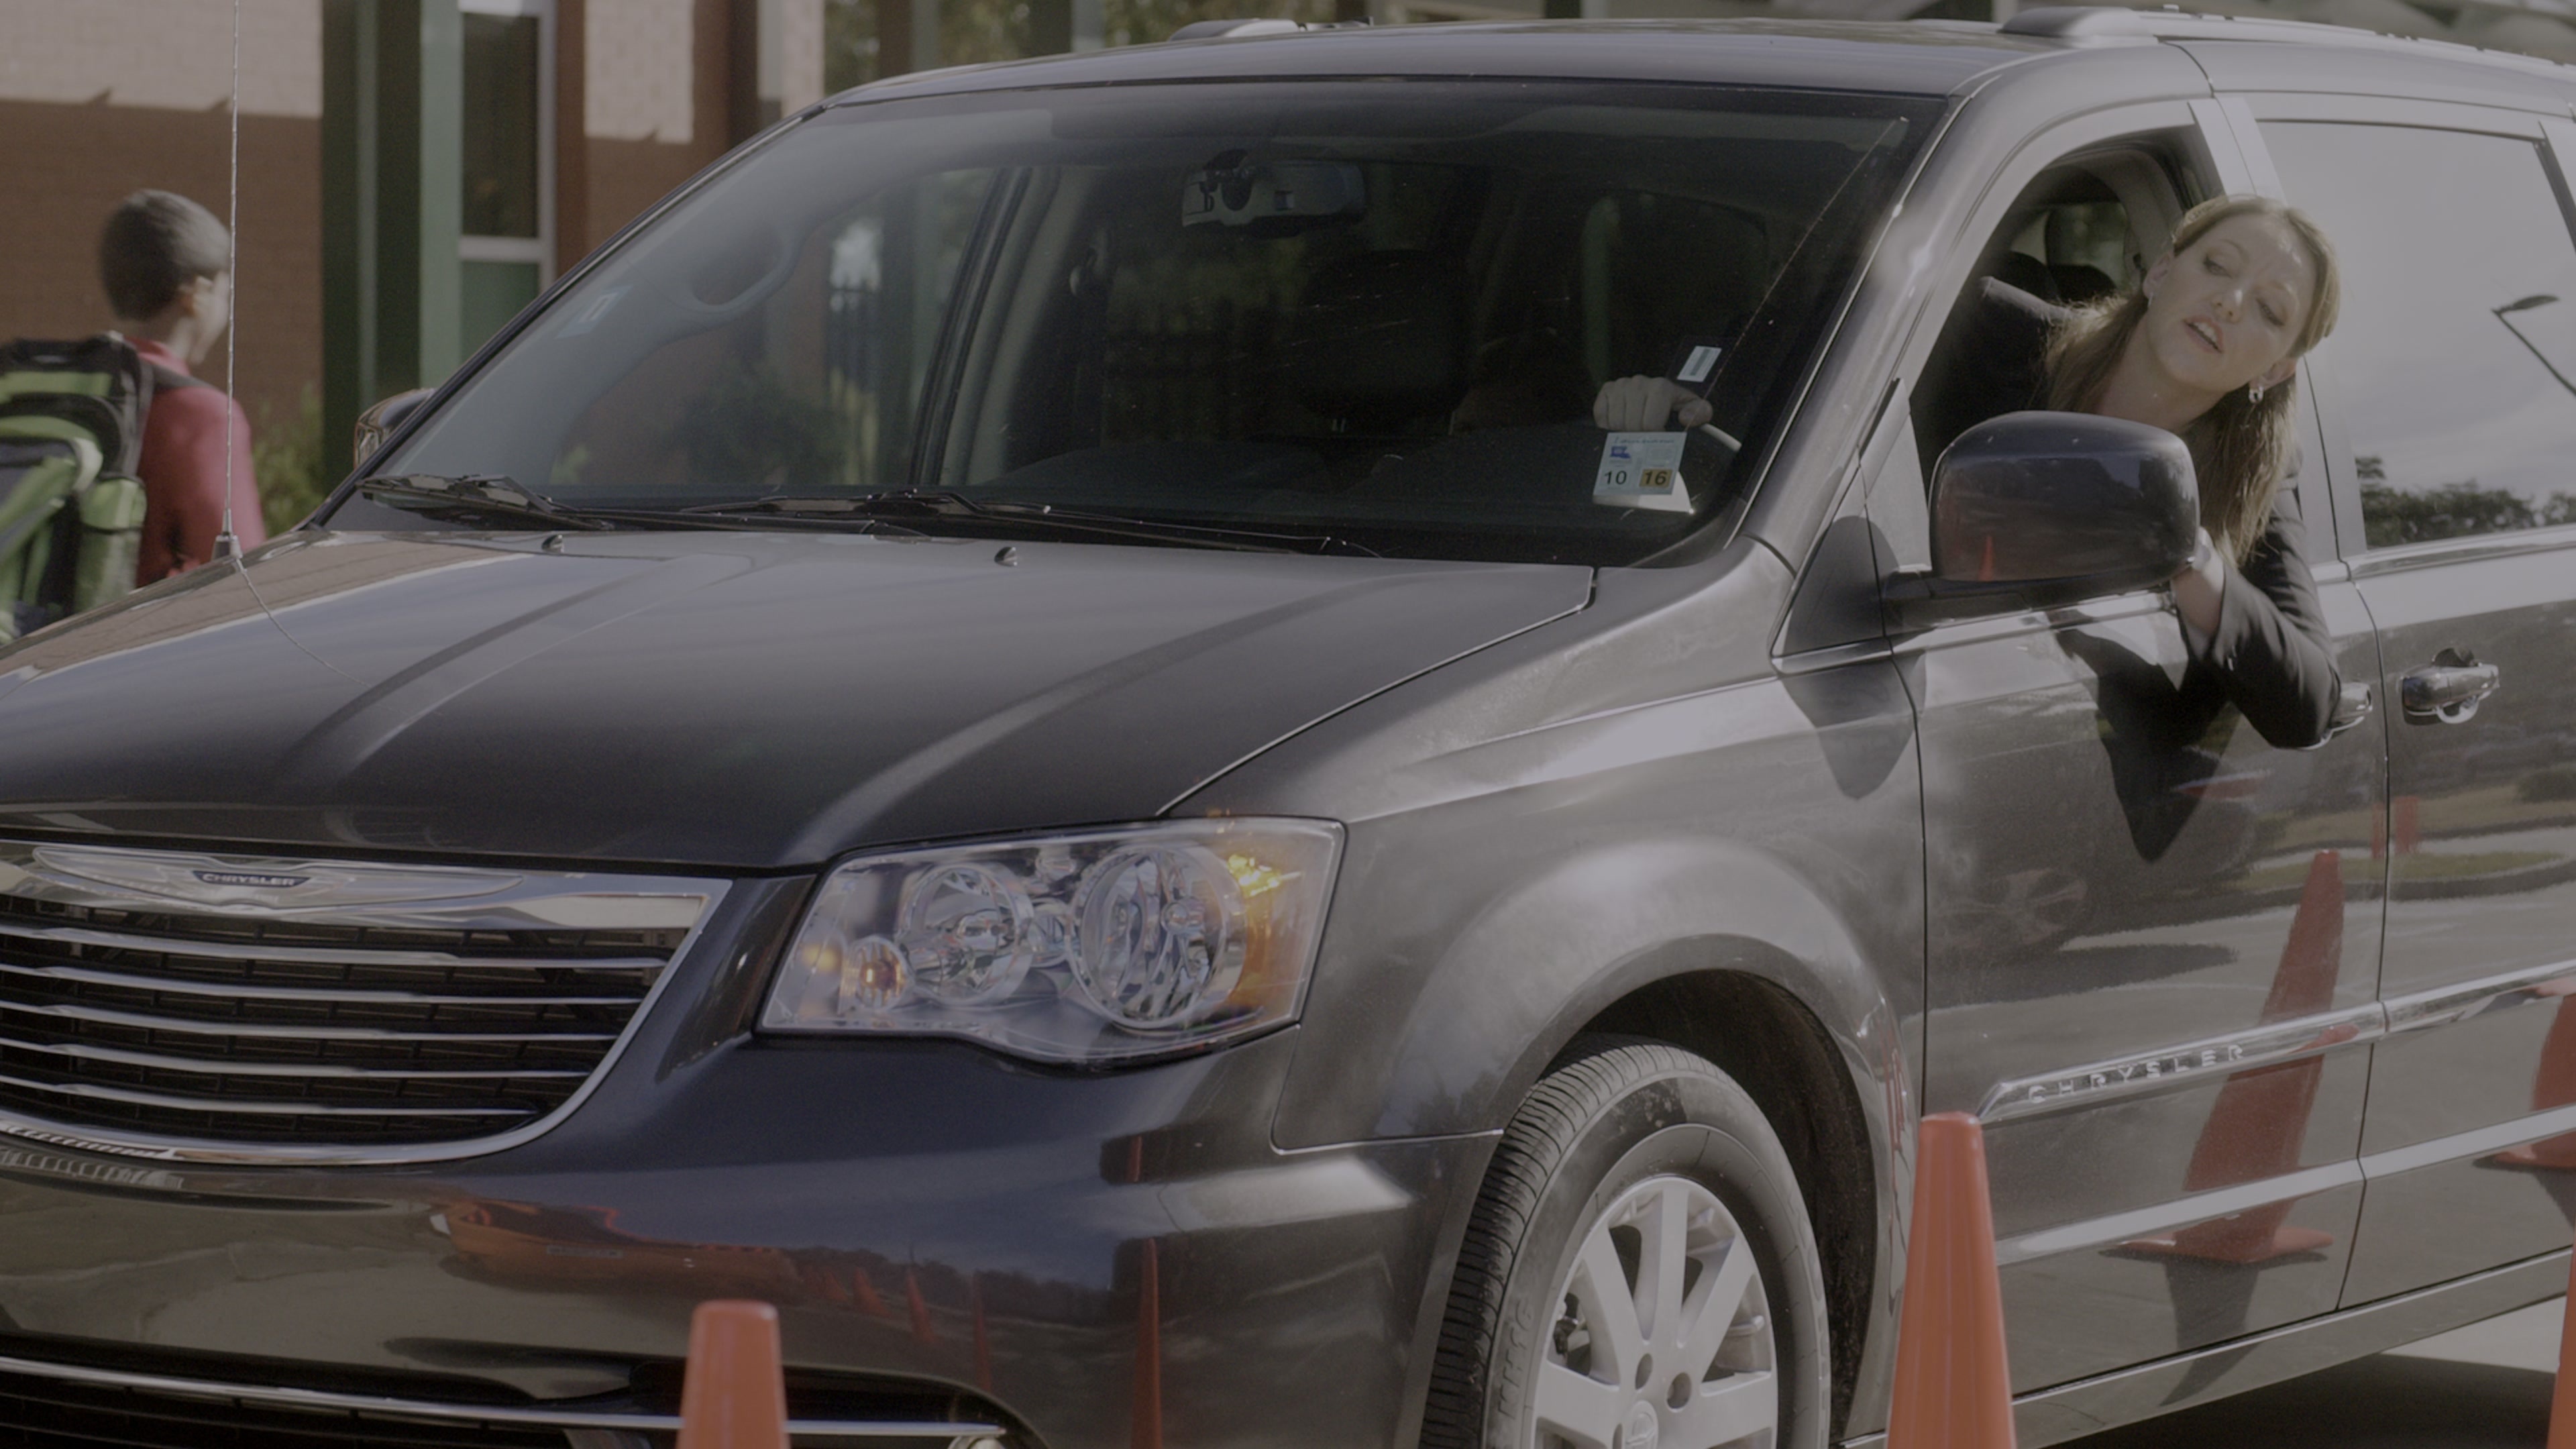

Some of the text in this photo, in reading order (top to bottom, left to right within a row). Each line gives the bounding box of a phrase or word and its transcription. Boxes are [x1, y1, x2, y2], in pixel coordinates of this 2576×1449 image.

[1604, 470, 1668, 486] 10 16
[203, 873, 295, 886] CHRYSLER
[2028, 1044, 2243, 1104] CHRYSLER
